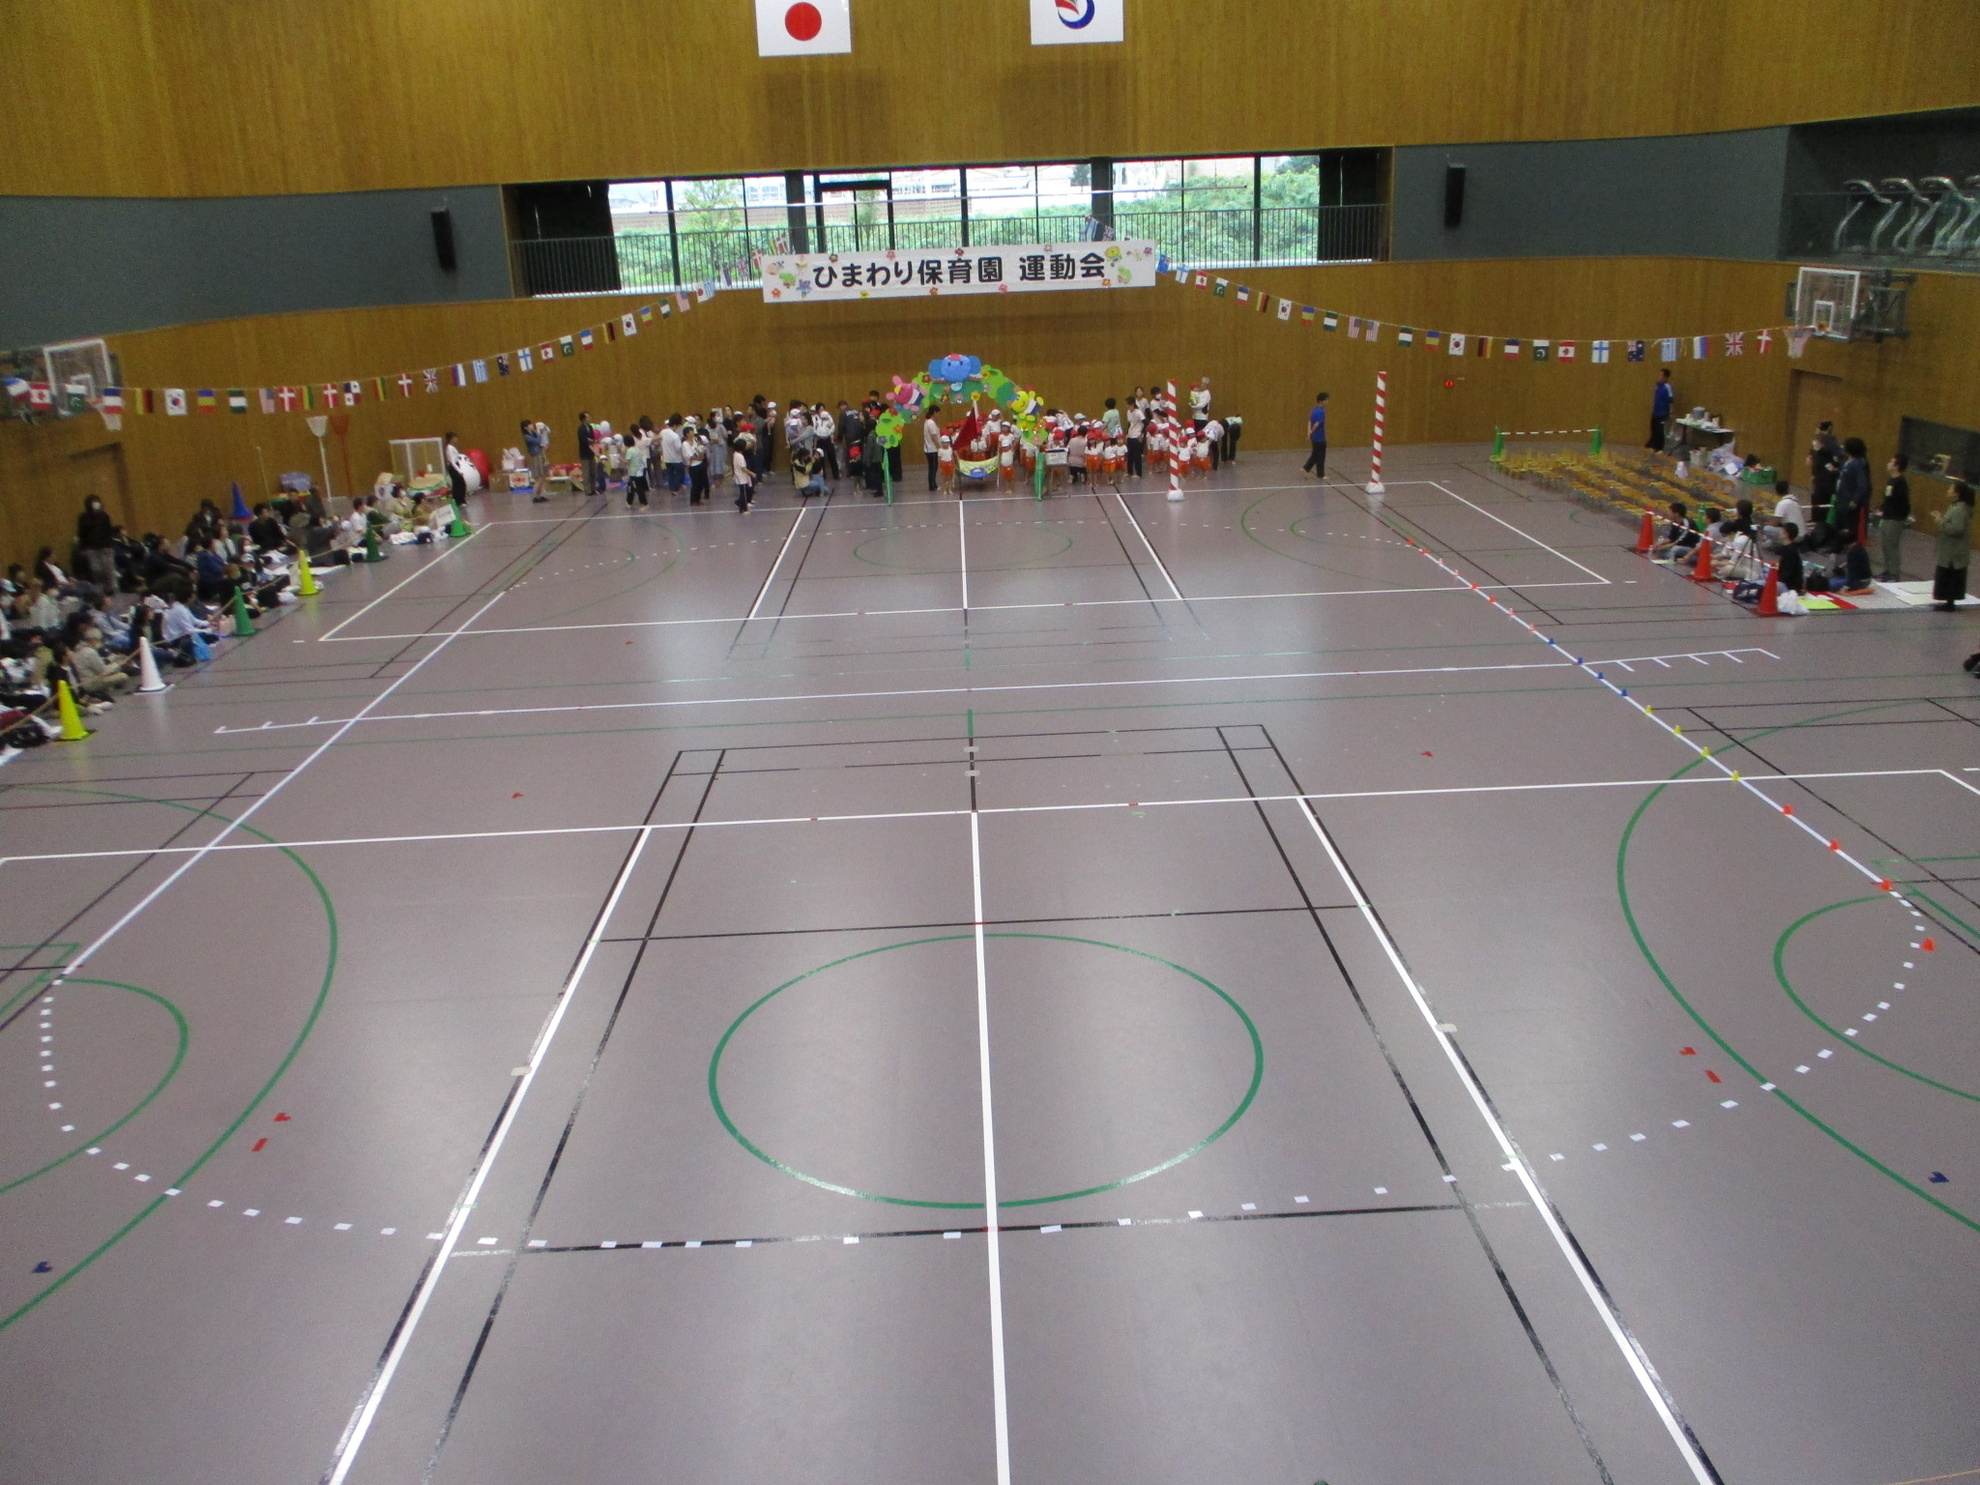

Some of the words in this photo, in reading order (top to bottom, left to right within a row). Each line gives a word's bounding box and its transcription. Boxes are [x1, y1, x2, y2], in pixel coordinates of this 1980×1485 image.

[813, 256, 1003, 289] ひまわり保育園
[1018, 252, 1105, 281] 運動会
